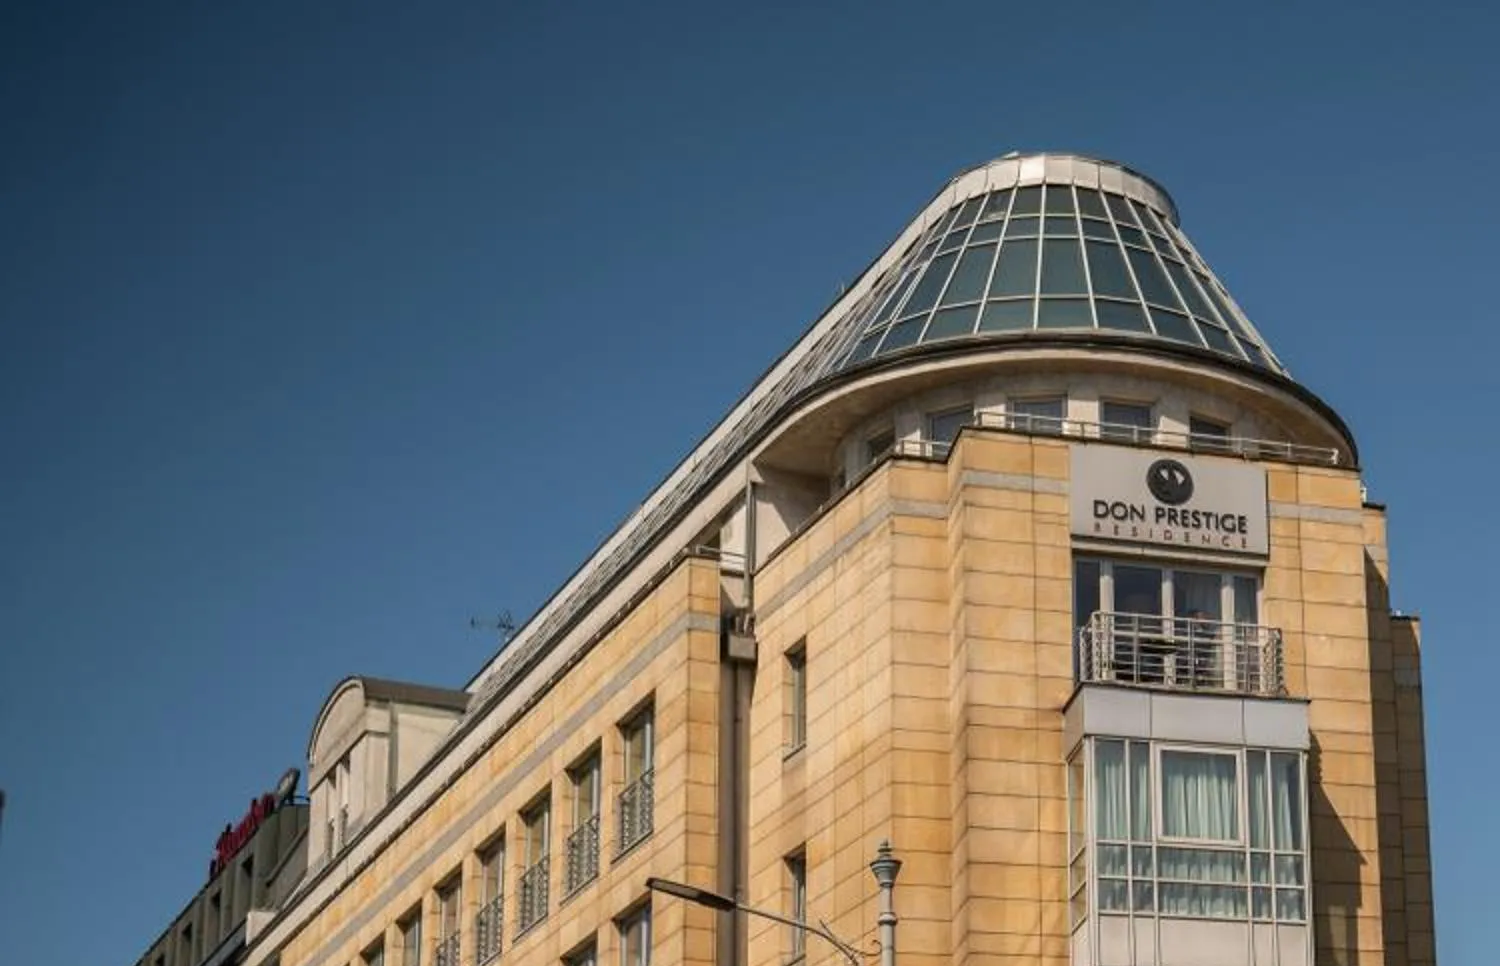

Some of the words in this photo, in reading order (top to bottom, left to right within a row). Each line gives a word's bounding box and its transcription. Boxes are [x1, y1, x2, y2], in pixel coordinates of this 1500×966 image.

[1093, 499, 1145, 523] DON
[1154, 506, 1247, 534] PRESTIGE
[1093, 522, 1247, 549] RESIDENCE
